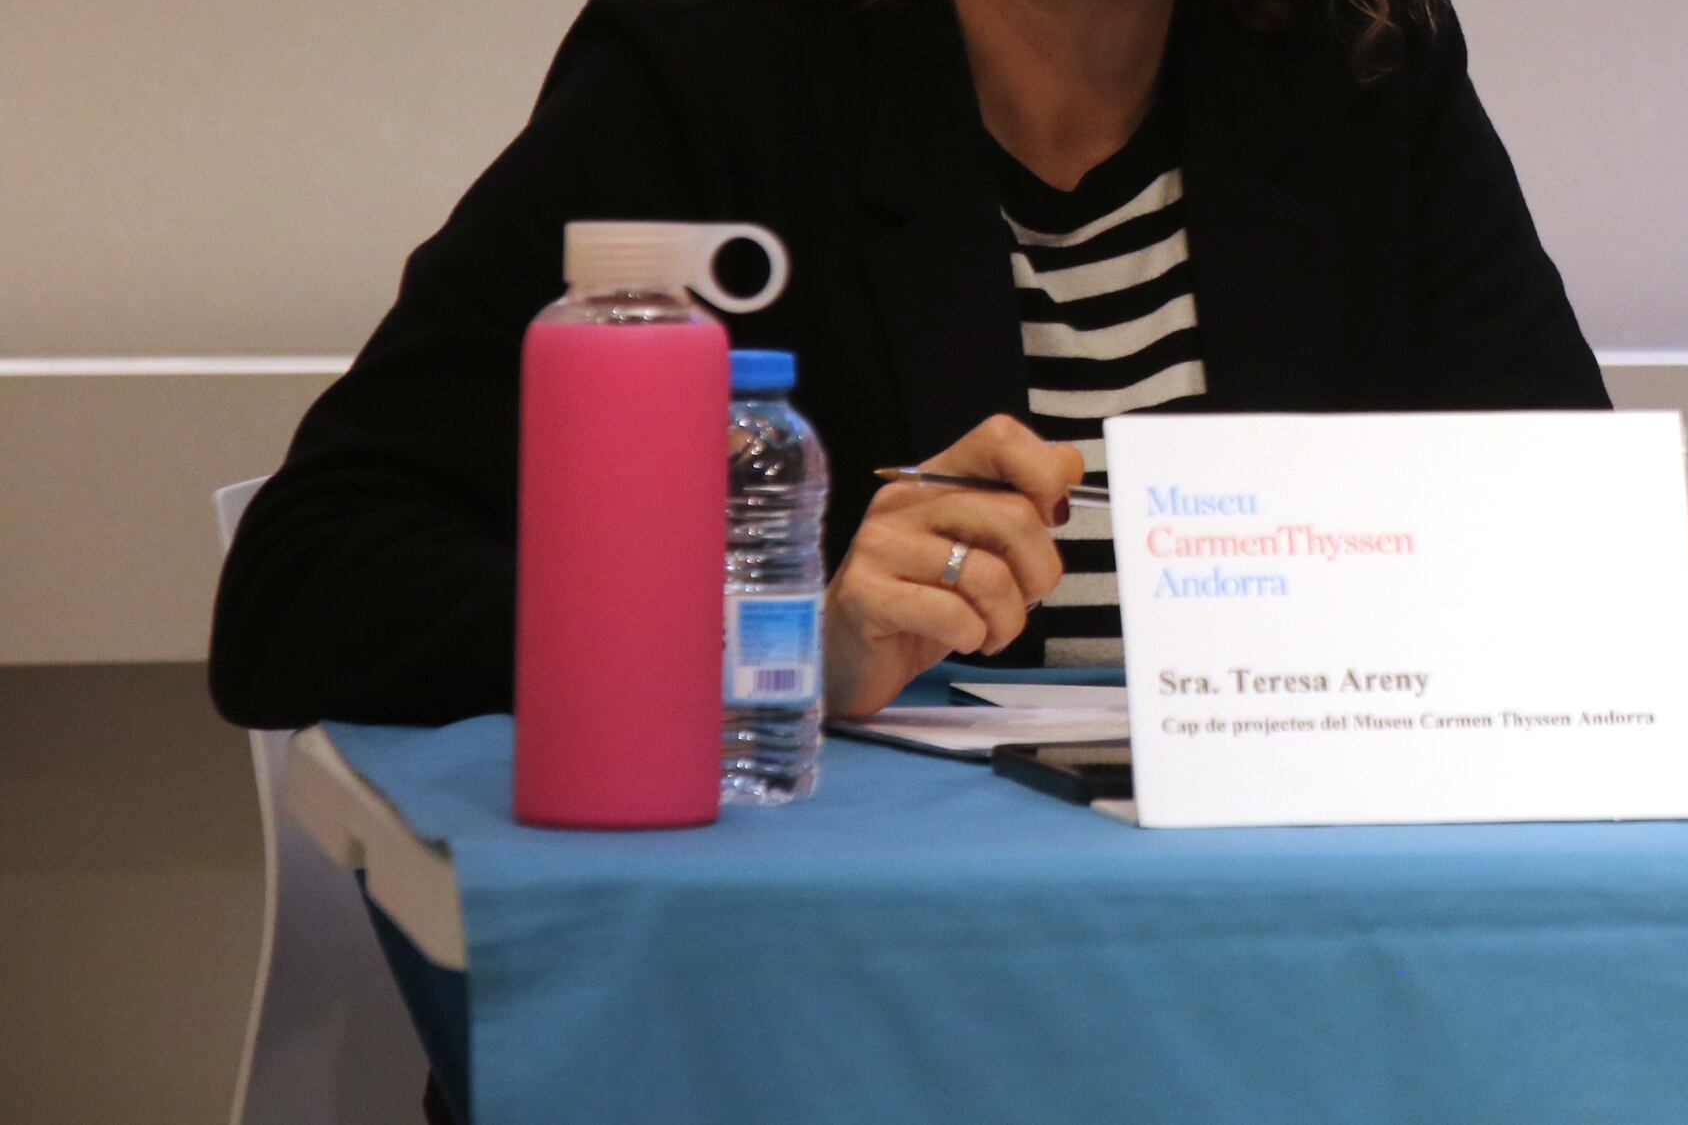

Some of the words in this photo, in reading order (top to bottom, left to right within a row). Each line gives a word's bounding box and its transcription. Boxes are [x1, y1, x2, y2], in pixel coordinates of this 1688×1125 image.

[1146, 485, 1259, 516] Museu
[1146, 524, 1415, 562] CarmenThyssen
[1154, 567, 1288, 598] Andorra
[1158, 669, 1220, 696] Sra.
[1229, 667, 1330, 695] Teresa
[1340, 667, 1428, 699] Areny
[1161, 717, 1201, 738] Cap
[1205, 717, 1227, 734] de
[1231, 716, 1315, 738] projectes
[1320, 714, 1348, 732] del
[1353, 713, 1414, 731] Museu
[1420, 712, 1493, 730] Carmen
[1500, 711, 1572, 731] Thyssen
[1579, 710, 1656, 726] Andorra
